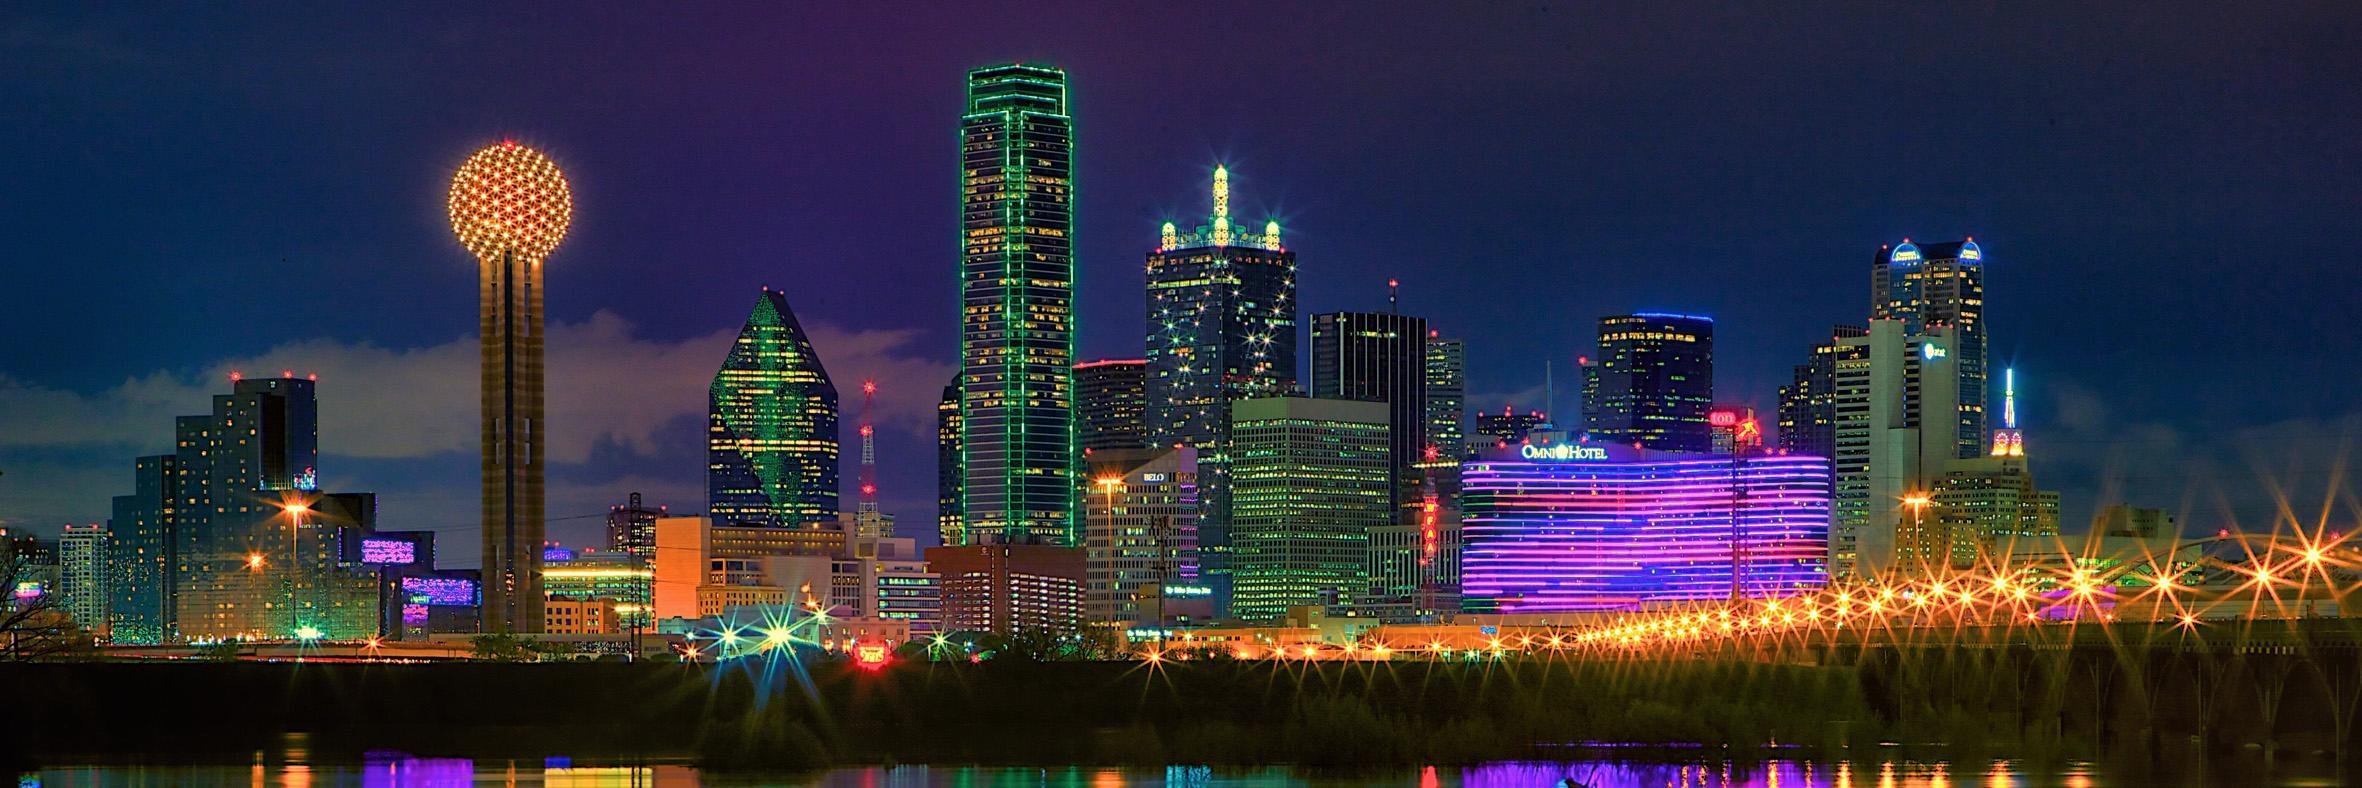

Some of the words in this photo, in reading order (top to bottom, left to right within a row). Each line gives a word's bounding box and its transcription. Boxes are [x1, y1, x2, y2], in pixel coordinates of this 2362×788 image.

[1522, 444, 1555, 459] OMNI
[1568, 445, 1607, 459] HOTEL
[1143, 473, 1165, 481] BELO
[1425, 502, 1436, 553] WFAA
